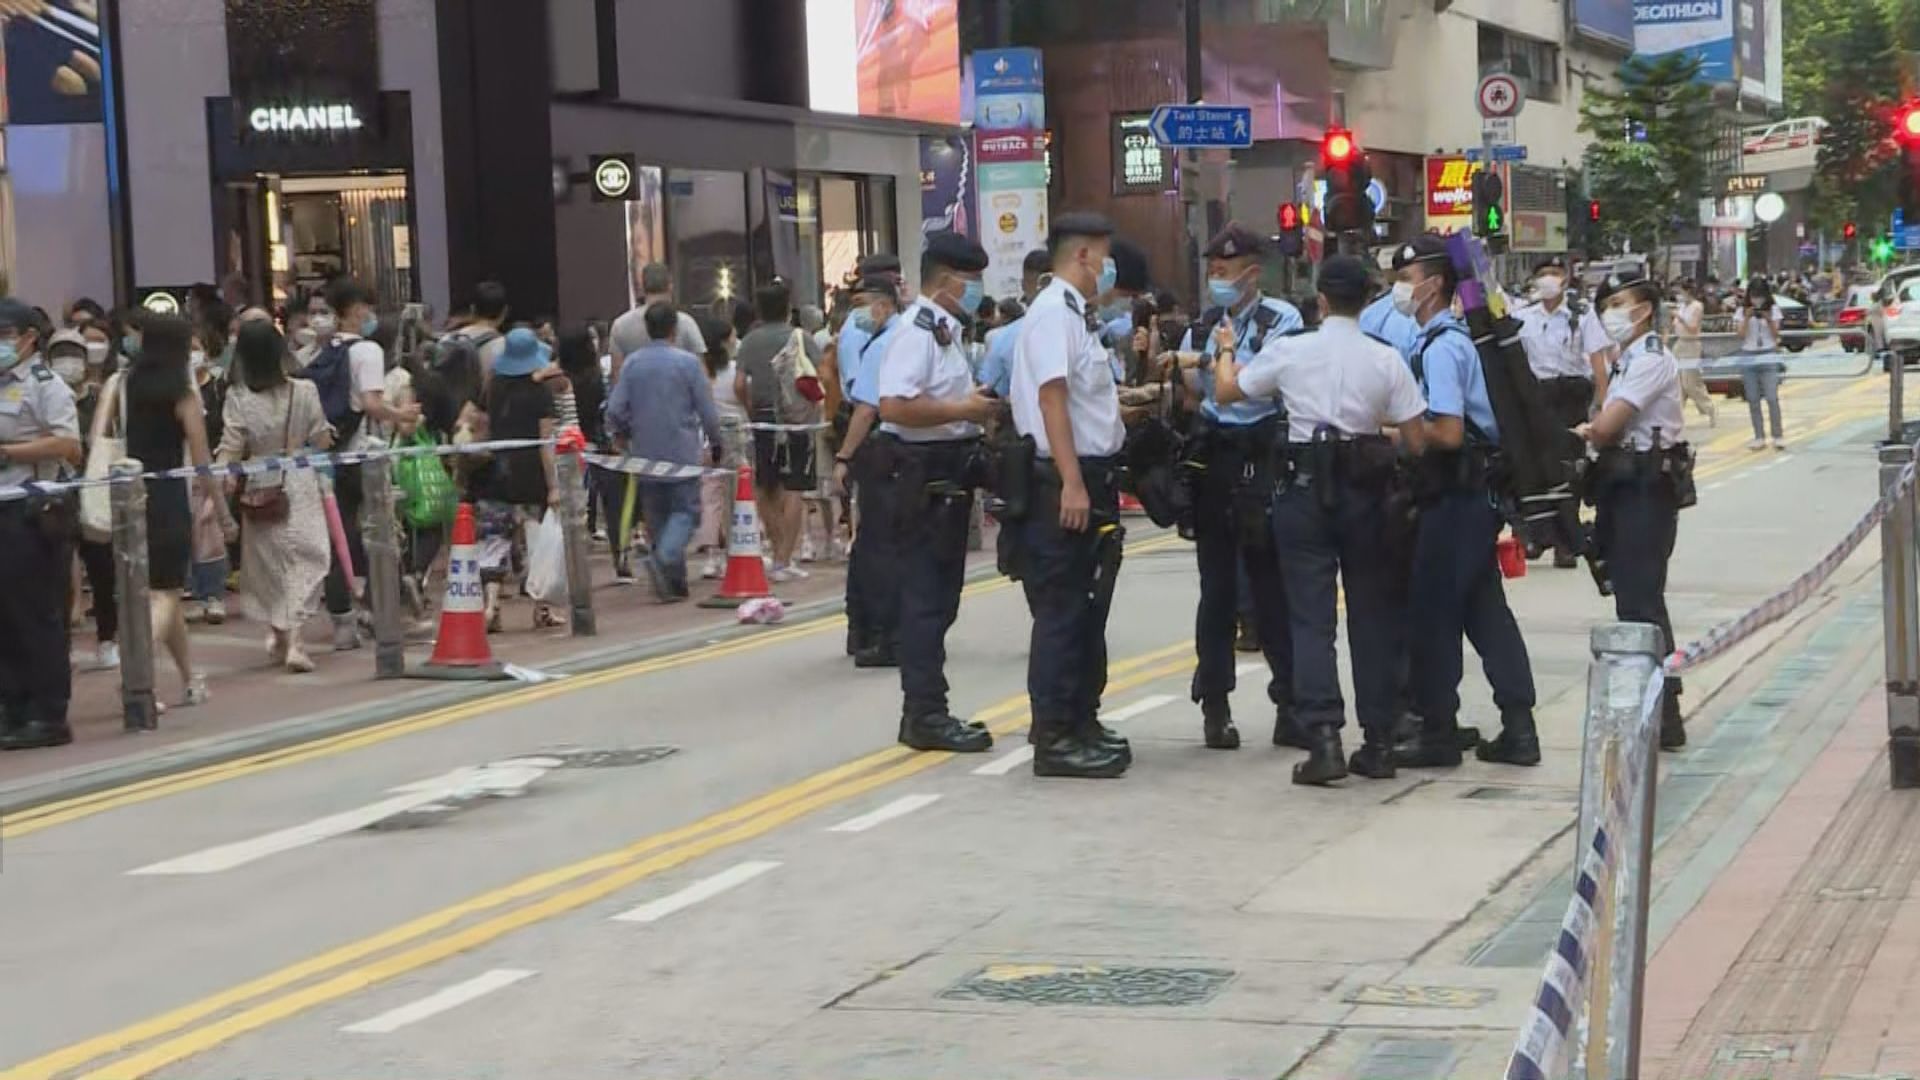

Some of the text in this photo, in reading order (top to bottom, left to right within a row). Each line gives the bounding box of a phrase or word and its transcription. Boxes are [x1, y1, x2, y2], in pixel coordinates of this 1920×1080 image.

[250, 104, 362, 132] CHANEL
[1173, 110, 1232, 121] Taxi Stand
[1178, 126, 1226, 140] 的士站
